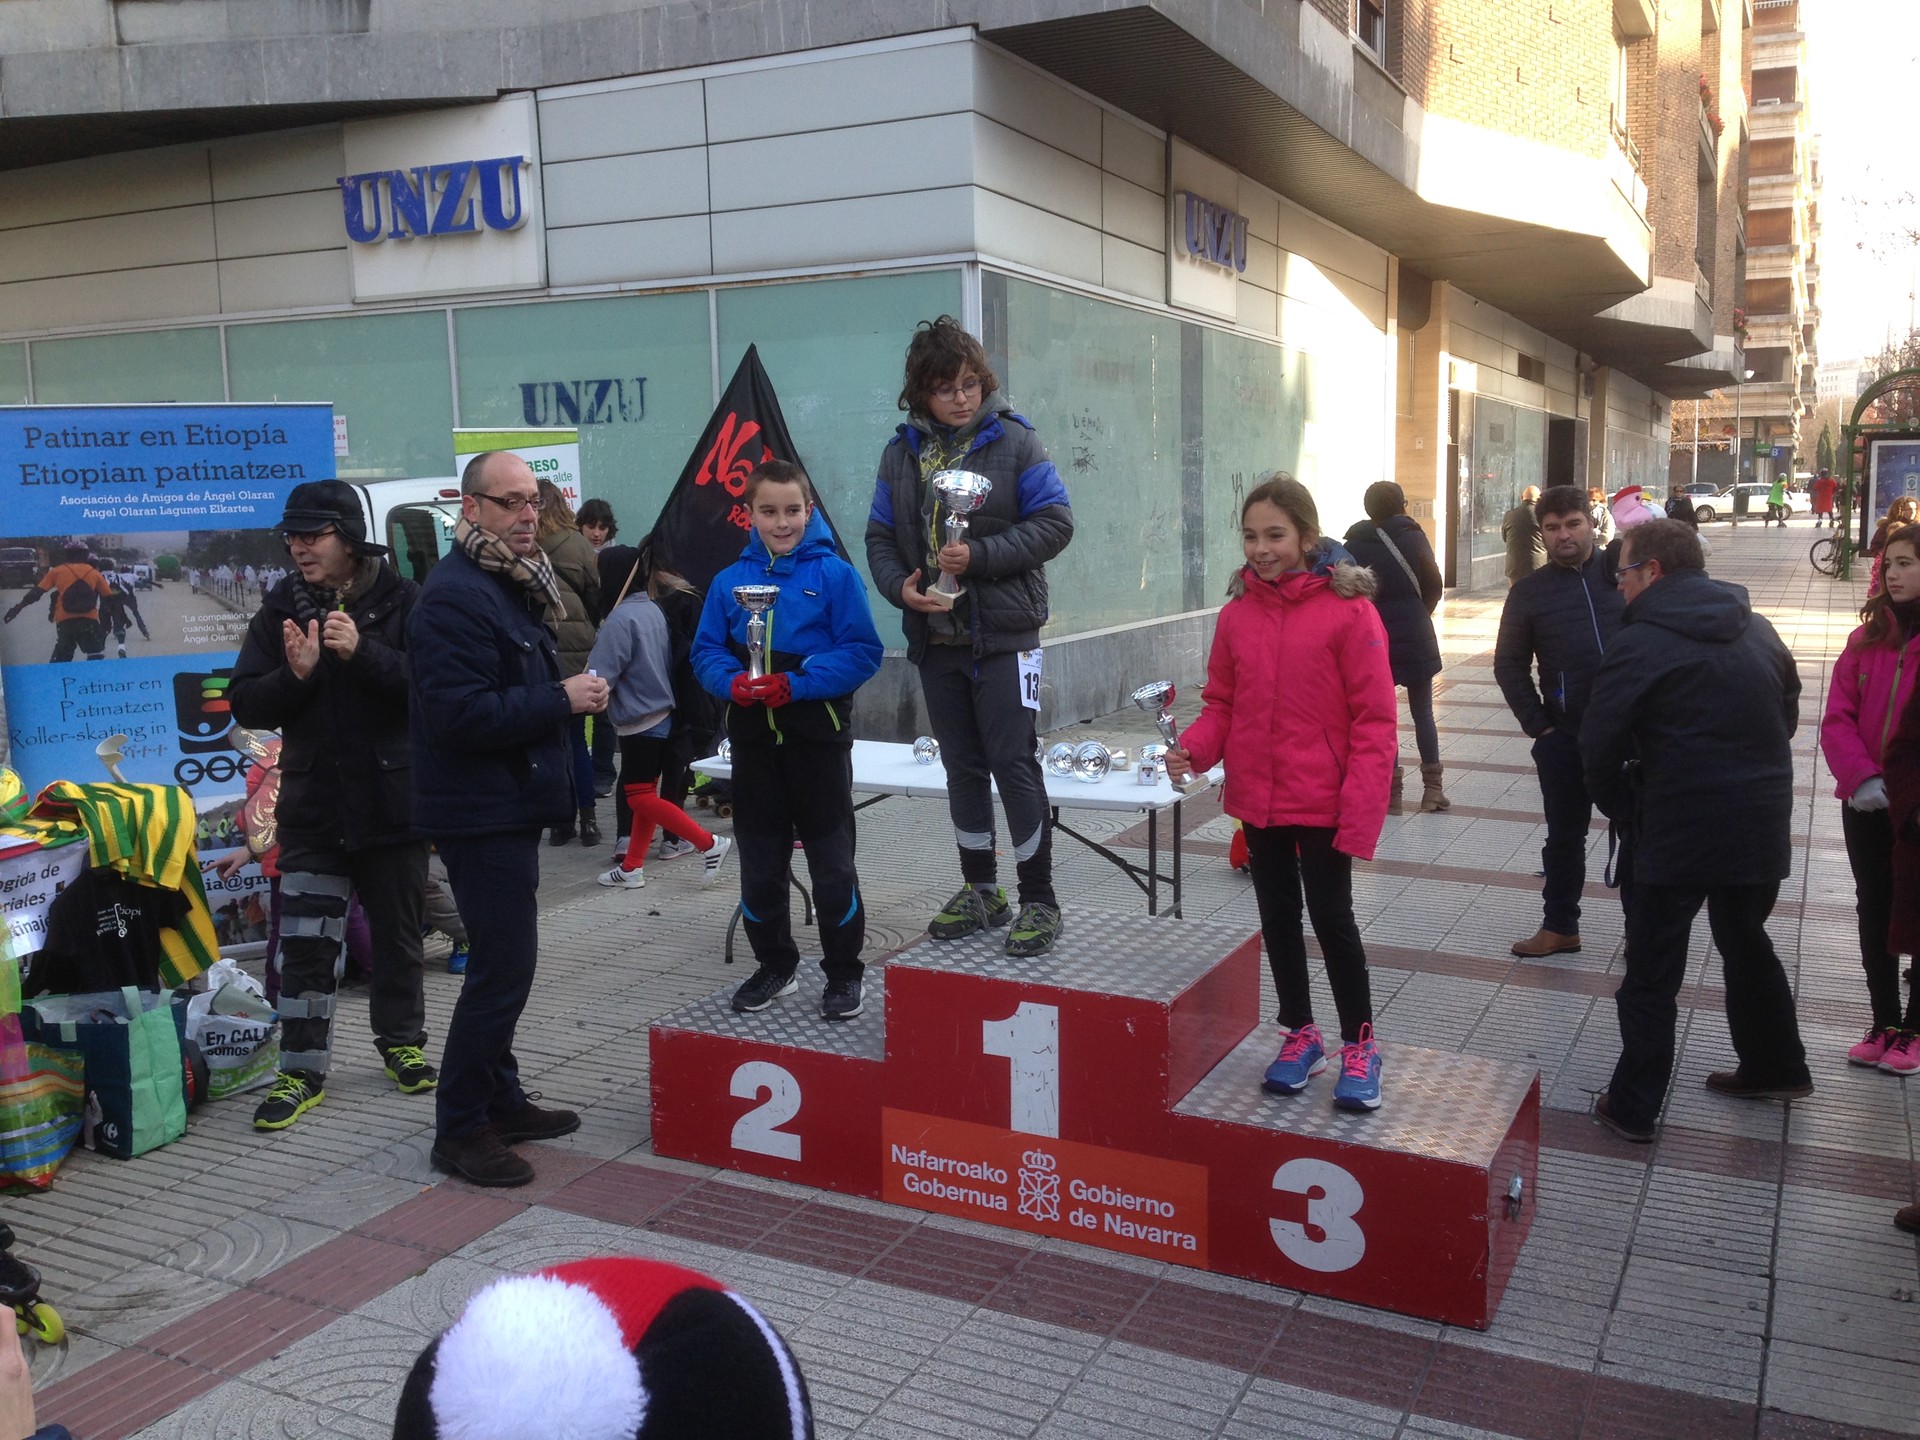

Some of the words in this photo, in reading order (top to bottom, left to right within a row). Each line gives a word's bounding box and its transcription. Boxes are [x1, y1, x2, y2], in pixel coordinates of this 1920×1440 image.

[336, 155, 530, 243] UNZU
[1175, 189, 1249, 273] UNZU
[518, 377, 647, 427] UNZU
[24, 426, 130, 449] Patinar
[140, 431, 176, 447] en
[184, 423, 288, 450] Etiopía
[19, 462, 148, 490] Etiopian
[154, 460, 306, 488] patinatzen
[553, 471, 573, 483] alde
[60, 494, 121, 505] Asociación
[124, 493, 138, 503] de
[142, 492, 183, 504] Amigos
[186, 491, 200, 501] de
[203, 489, 236, 503] Ángel
[238, 490, 275, 500] Olaran
[120, 506, 157, 517] Olaran
[159, 506, 207, 517] Lagunen
[209, 504, 255, 514] Elkartea
[182, 624, 215, 633] cuando
[216, 623, 225, 631] la
[198, 612, 245, 622] compasión
[210, 633, 240, 642] Olaran
[62, 676, 135, 699] Patinar
[139, 680, 162, 689] en
[1024, 671, 1039, 702] 13
[61, 701, 165, 722] Patinatzen
[10, 722, 147, 749] Roller-skating
[150, 721, 167, 735] in
[41, 864, 60, 879] de
[206, 1031, 226, 1046] En
[206, 1045, 250, 1057] somos
[982, 1001, 1060, 1140] 1
[729, 1060, 802, 1162] 2
[891, 1144, 1009, 1185] Nafarroako
[903, 1172, 1008, 1212] Gobernua
[1069, 1179, 1175, 1218] Gobierno
[1267, 1157, 1365, 1273] 3
[1069, 1208, 1097, 1230] de
[1103, 1212, 1197, 1251] Navarra
